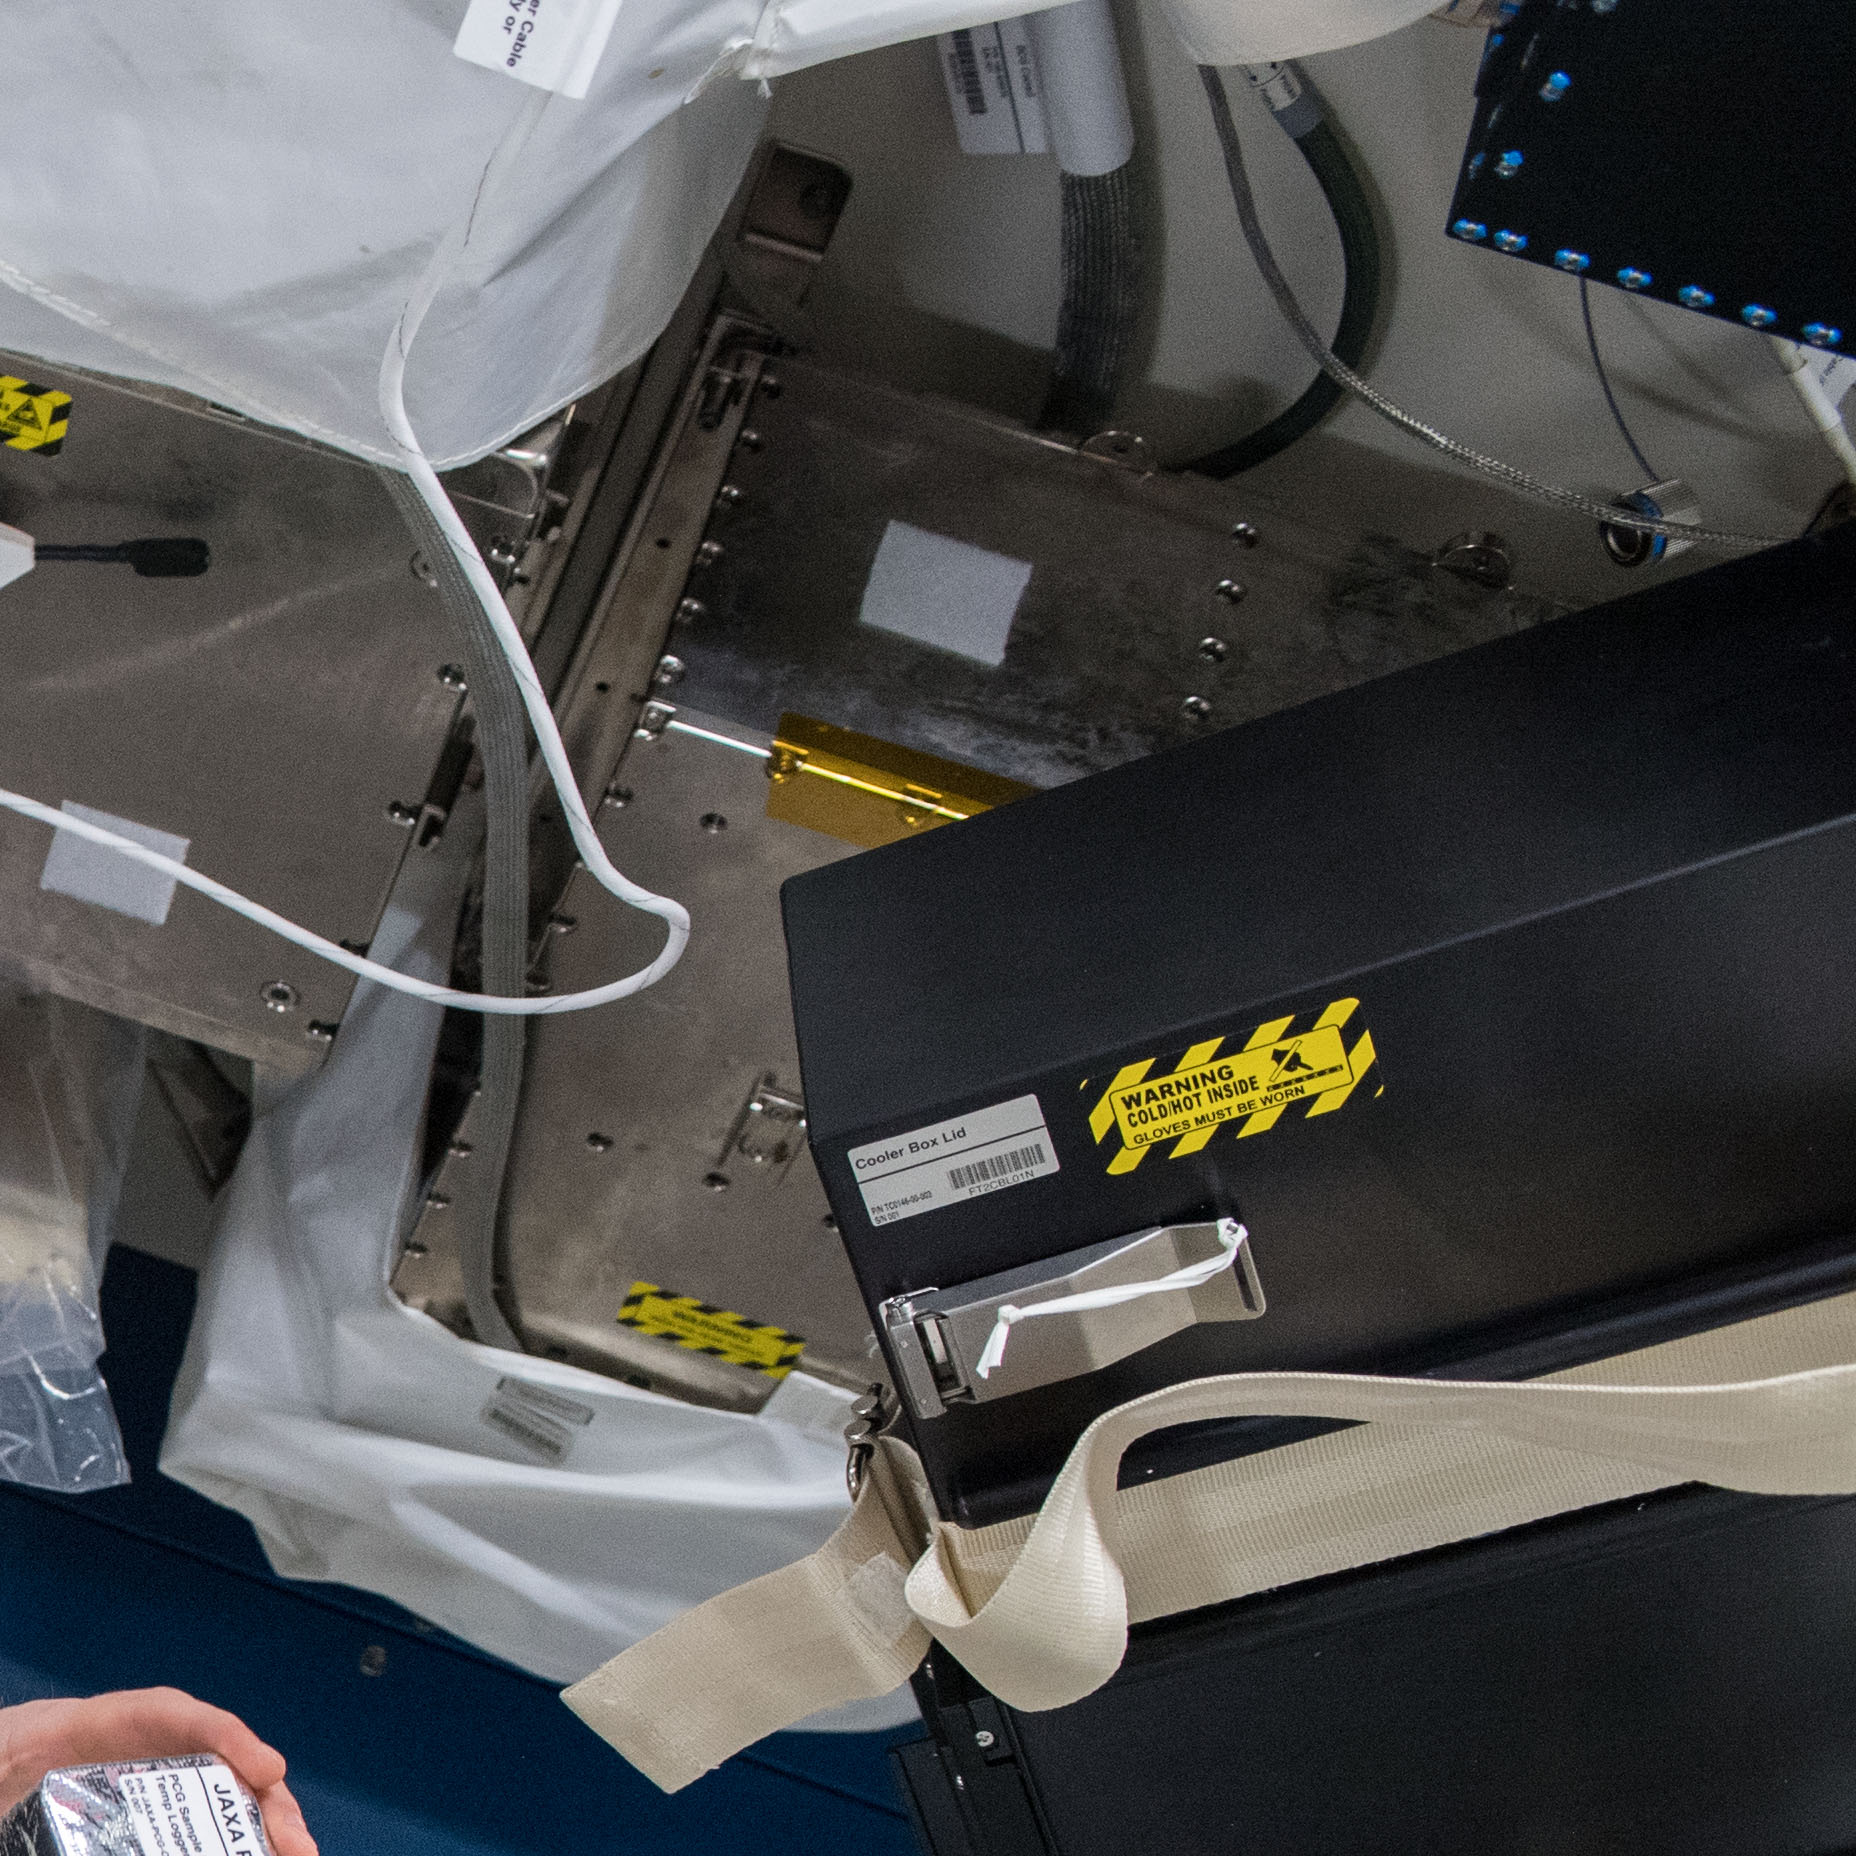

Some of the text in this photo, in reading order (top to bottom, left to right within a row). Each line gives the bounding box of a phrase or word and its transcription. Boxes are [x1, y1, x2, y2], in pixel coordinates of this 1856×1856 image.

[501, 14, 517, 35] or
[505, 18, 535, 69] Cable
[1120, 1064, 1234, 1111] WARNING
[1126, 1075, 1259, 1128] COLD/HOT INSIDE
[1133, 1084, 1306, 1145] GLOVES MUST BE WORN
[854, 1126, 966, 1170] Cooler Box Lid
[968, 1169, 1034, 1195] FT2CBL01N
[871, 1205, 884, 1215] P/N
[874, 1211, 899, 1224] S/N 001
[122, 1777, 143, 1815] S/N 007
[132, 1776, 147, 1795] P/N
[150, 1773, 176, 1812] Temp
[166, 1771, 187, 1803] PCG
[175, 1804, 205, 1855] Sample
[210, 1779, 247, 1844] JAXA
